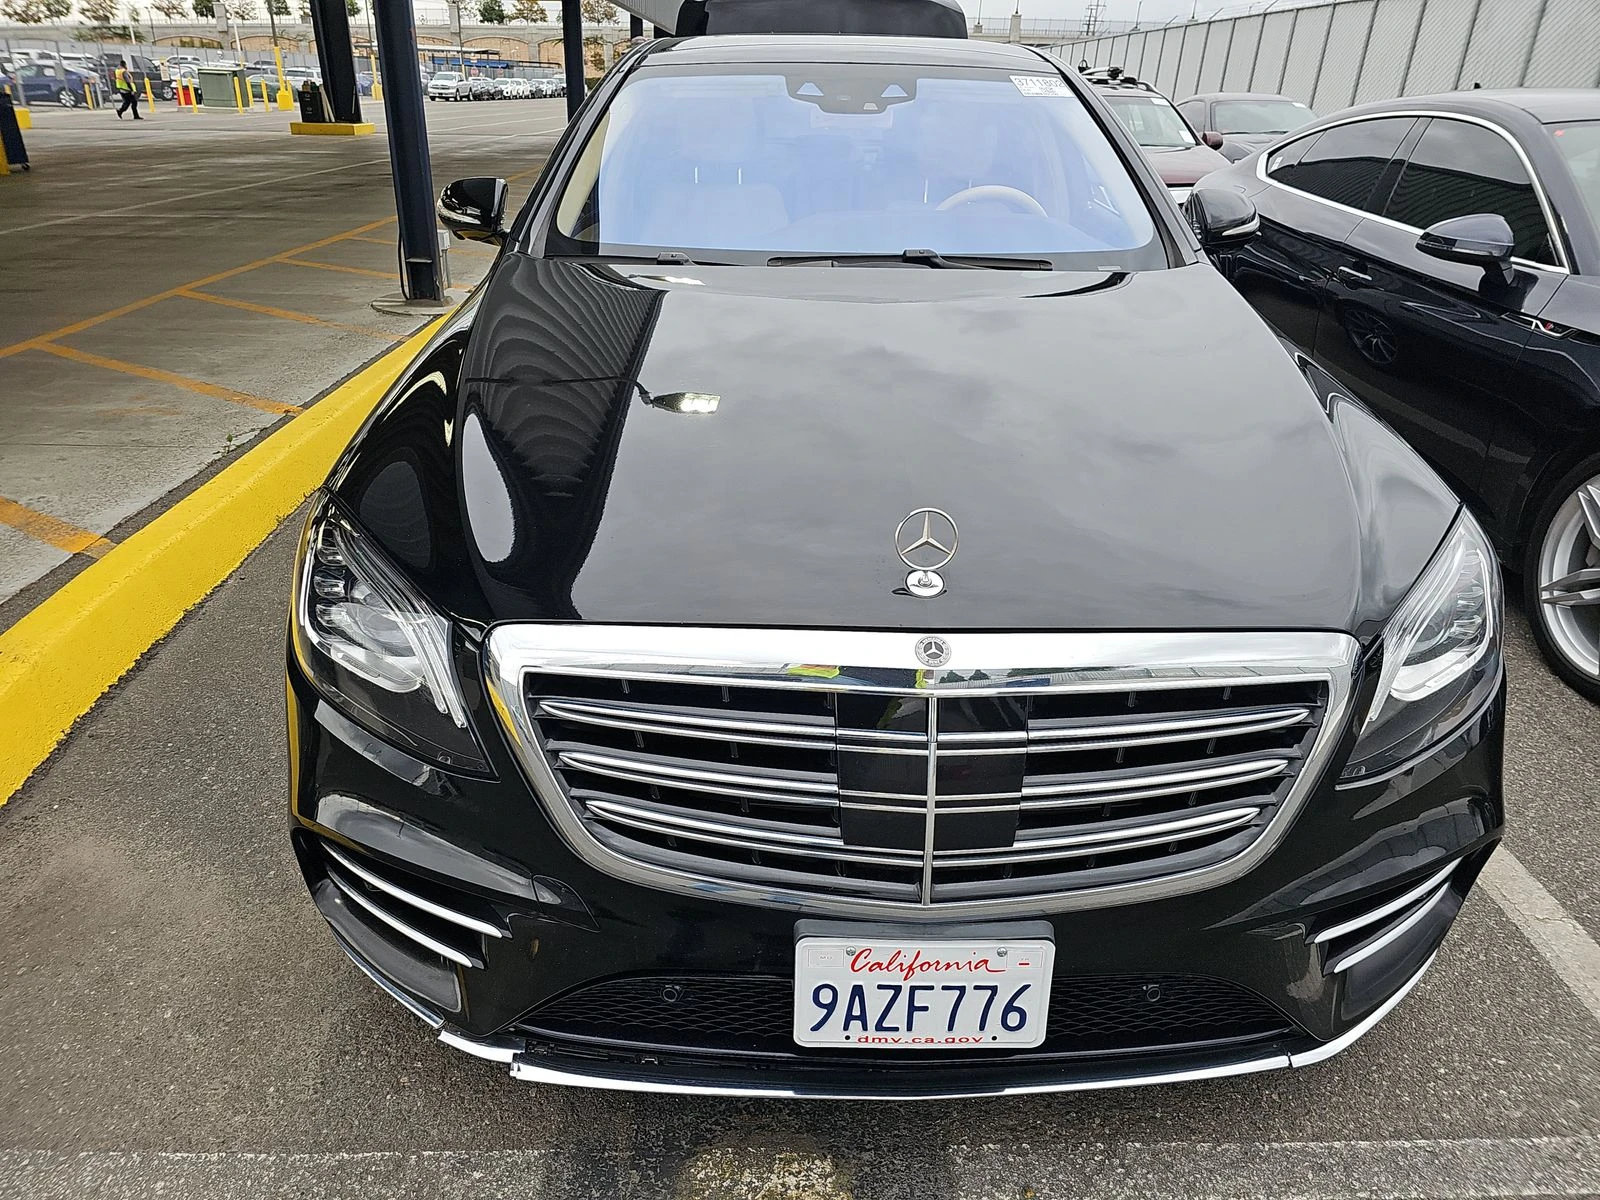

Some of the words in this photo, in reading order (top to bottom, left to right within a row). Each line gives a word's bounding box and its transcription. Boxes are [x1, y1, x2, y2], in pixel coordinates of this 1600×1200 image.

[850, 948, 1006, 981] California
[810, 983, 1032, 1032] 9AZF776
[857, 1035, 984, 1044] dmv.ca.gov
